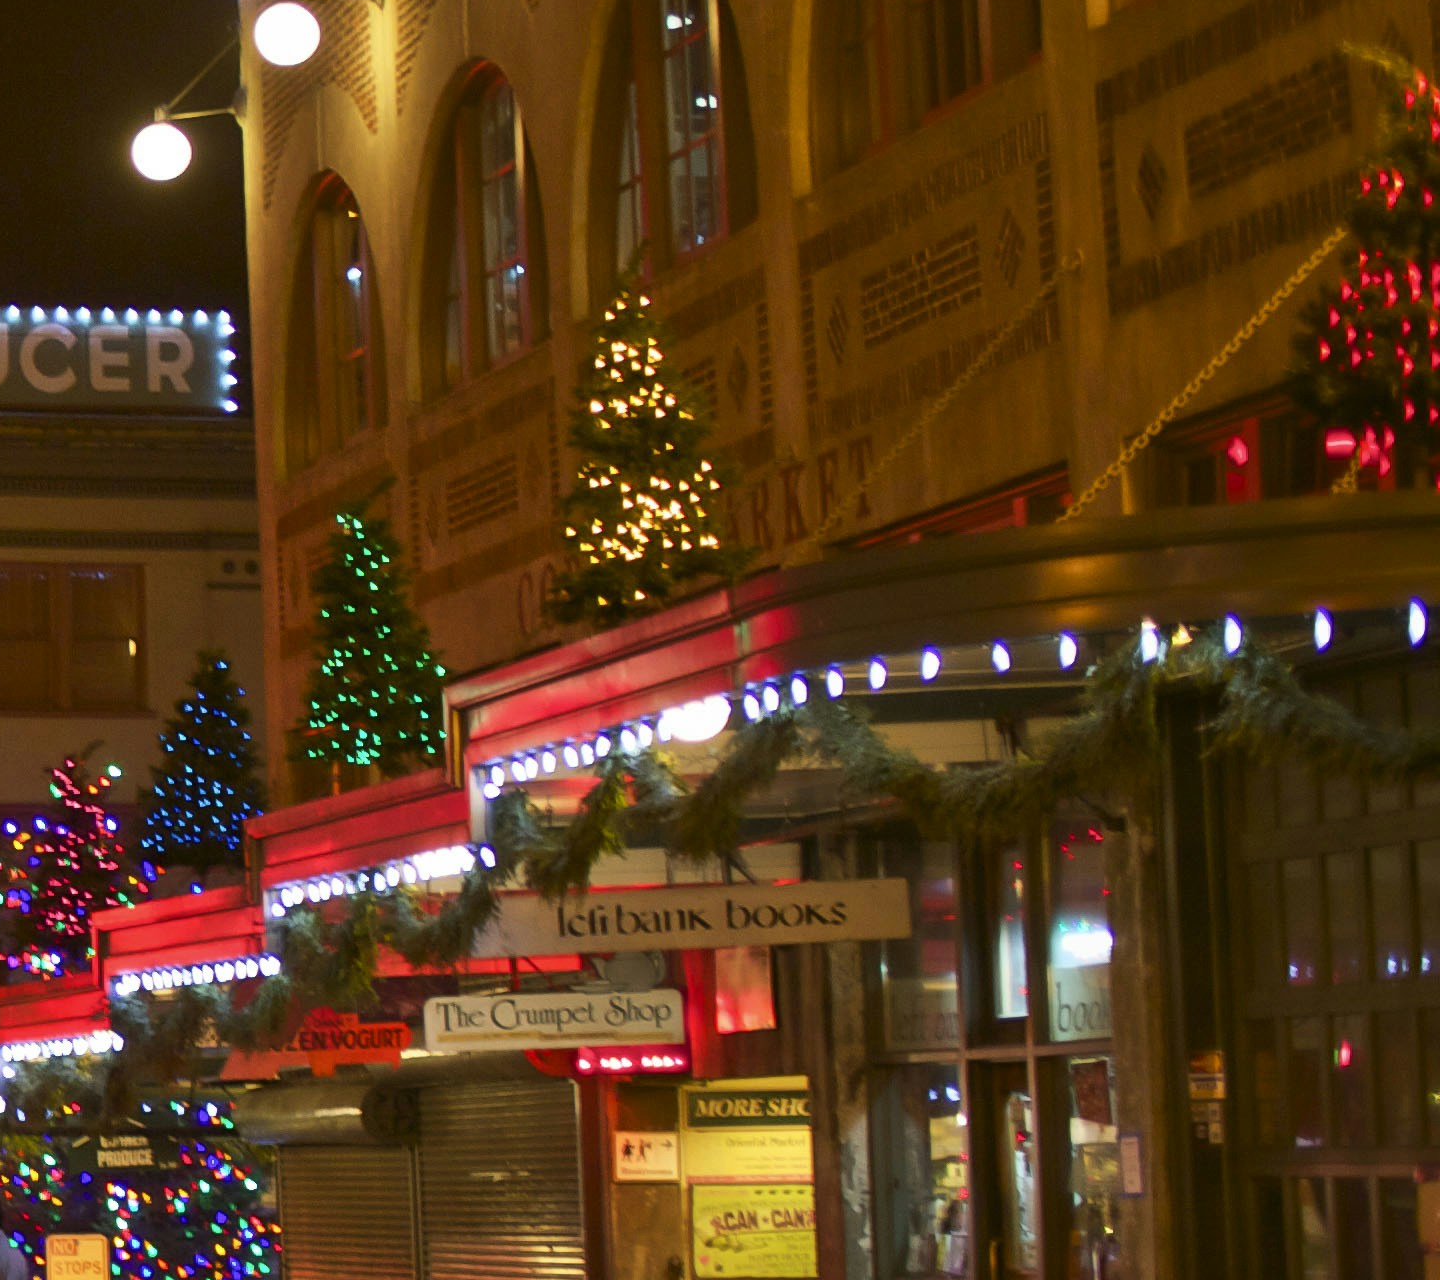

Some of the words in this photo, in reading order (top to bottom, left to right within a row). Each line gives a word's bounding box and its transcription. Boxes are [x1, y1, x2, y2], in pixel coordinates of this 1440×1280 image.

[616, 900, 712, 935] bank
[726, 896, 848, 930] books
[436, 1000, 486, 1032] The
[490, 998, 596, 1032] Crumpet
[604, 998, 673, 1026] Shop
[332, 1027, 405, 1050] YOGURT
[696, 1097, 765, 1118] MORE
[53, 1239, 77, 1256] NO
[54, 1259, 103, 1276] STOPS
